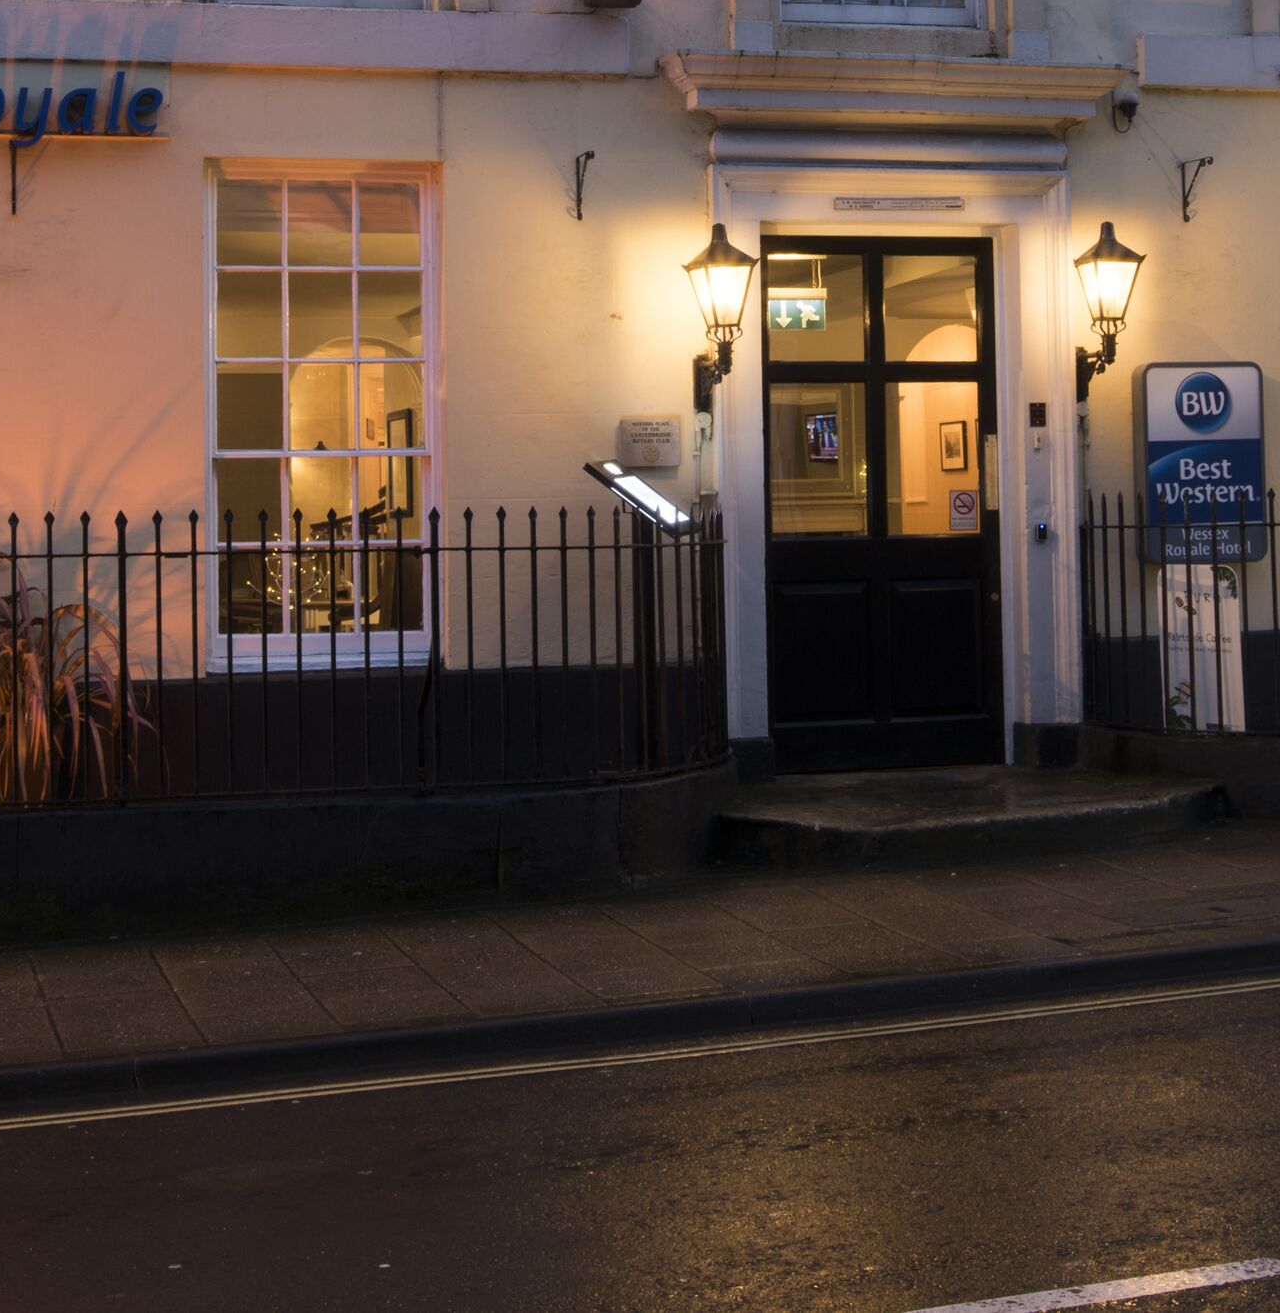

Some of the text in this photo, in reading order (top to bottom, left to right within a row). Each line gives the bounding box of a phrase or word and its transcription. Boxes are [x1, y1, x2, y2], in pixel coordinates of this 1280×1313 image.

[1182, 391, 1225, 416] BW
[1179, 458, 1233, 480] Best
[1214, 540, 1251, 555] Hotl
